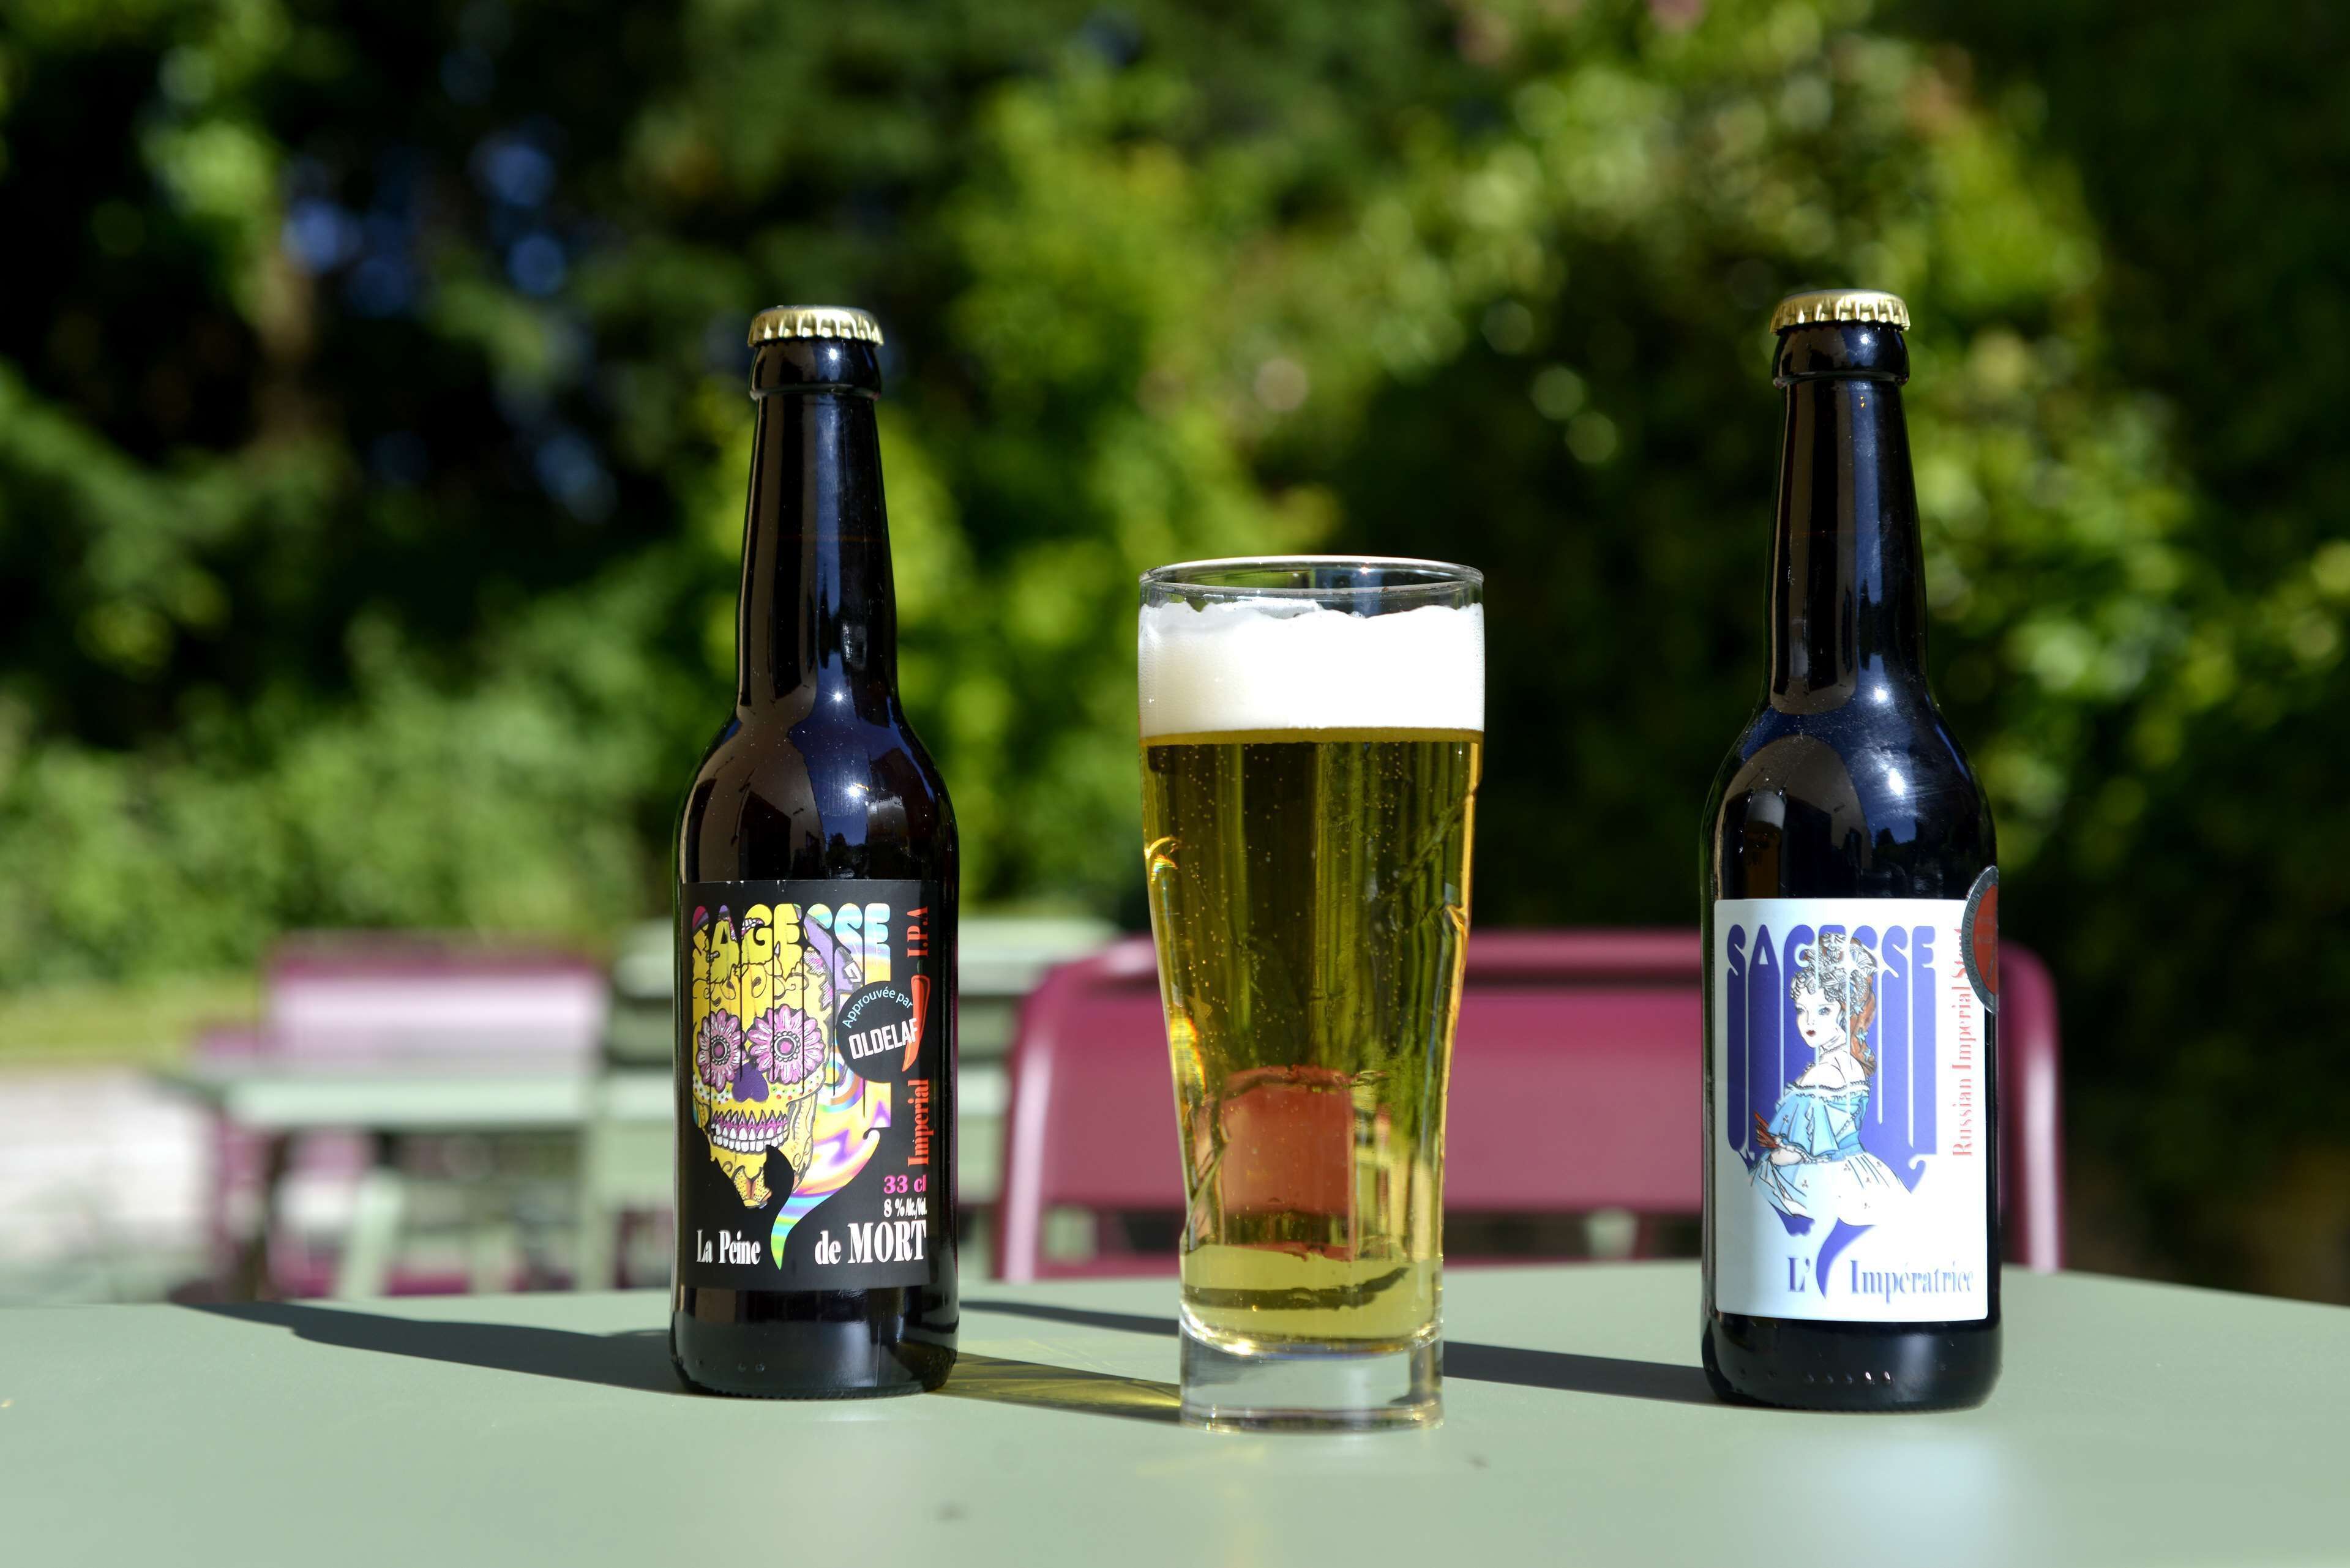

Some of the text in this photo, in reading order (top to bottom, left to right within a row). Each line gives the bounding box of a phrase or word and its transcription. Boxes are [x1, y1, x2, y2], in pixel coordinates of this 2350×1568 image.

[842, 986, 913, 1029] Approuvée par
[1951, 987, 1977, 1070] Imperial
[848, 1018, 918, 1059] OLDELAF
[907, 1079, 935, 1167] Imperial
[1952, 1079, 1973, 1156] Russian
[883, 1174, 927, 1194] 33 cl
[883, 1198, 892, 1217] 8
[696, 1220, 927, 1265] La Peine de MORT
[1787, 1257, 1974, 1304] L' Impératrice
